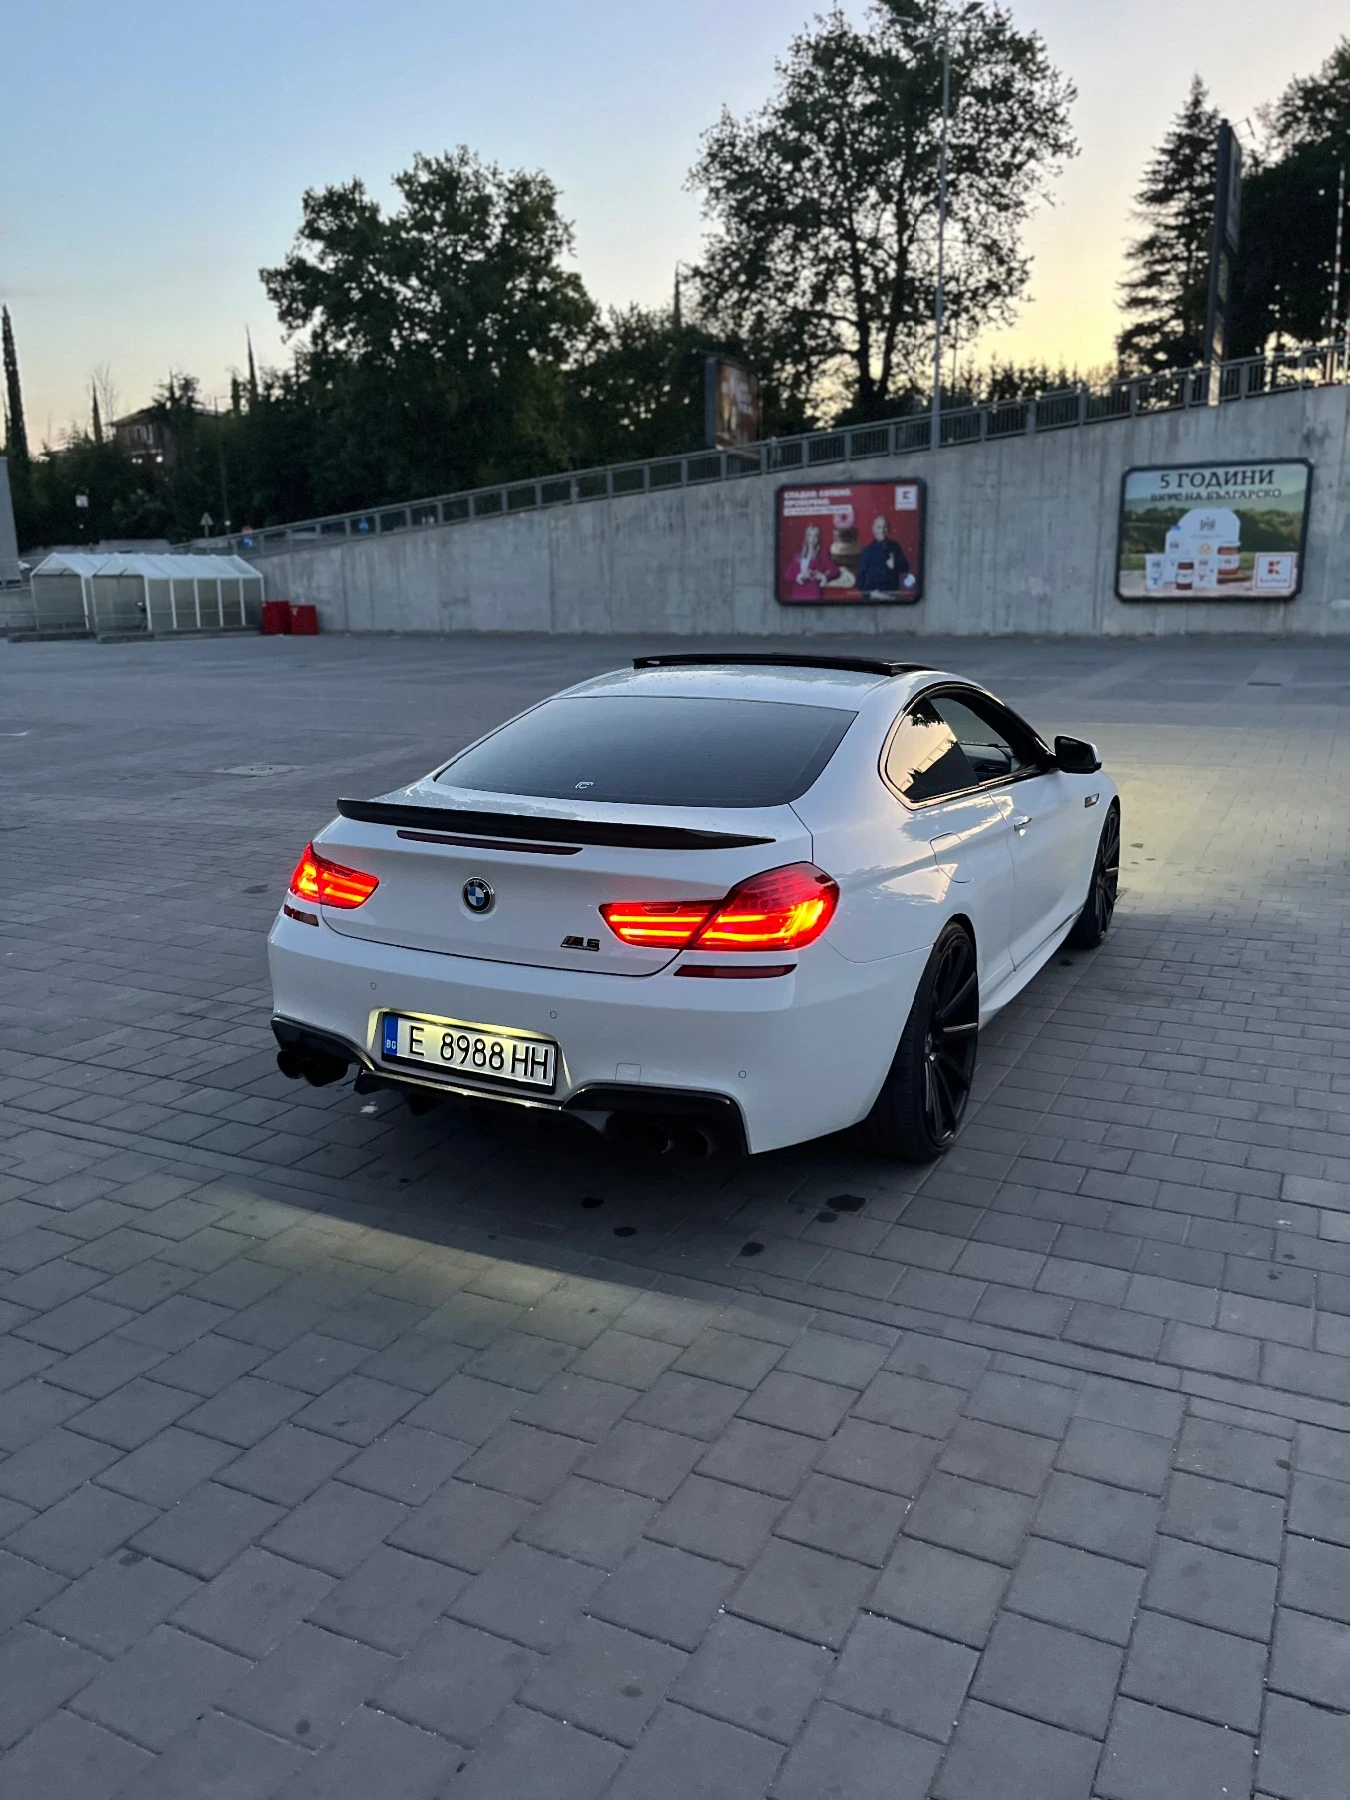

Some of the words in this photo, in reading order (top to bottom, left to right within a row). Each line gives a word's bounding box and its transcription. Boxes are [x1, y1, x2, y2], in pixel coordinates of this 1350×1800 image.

[1160, 473, 1170, 489] 5
[1177, 468, 1275, 490] ГОДИНИ
[1185, 491, 1203, 501] НА
[1206, 488, 1282, 501] БЪЛГАРСКО
[386, 1039, 397, 1050] BG
[409, 1025, 425, 1057] E
[440, 1032, 504, 1071] 8988
[510, 1043, 549, 1080] HH
